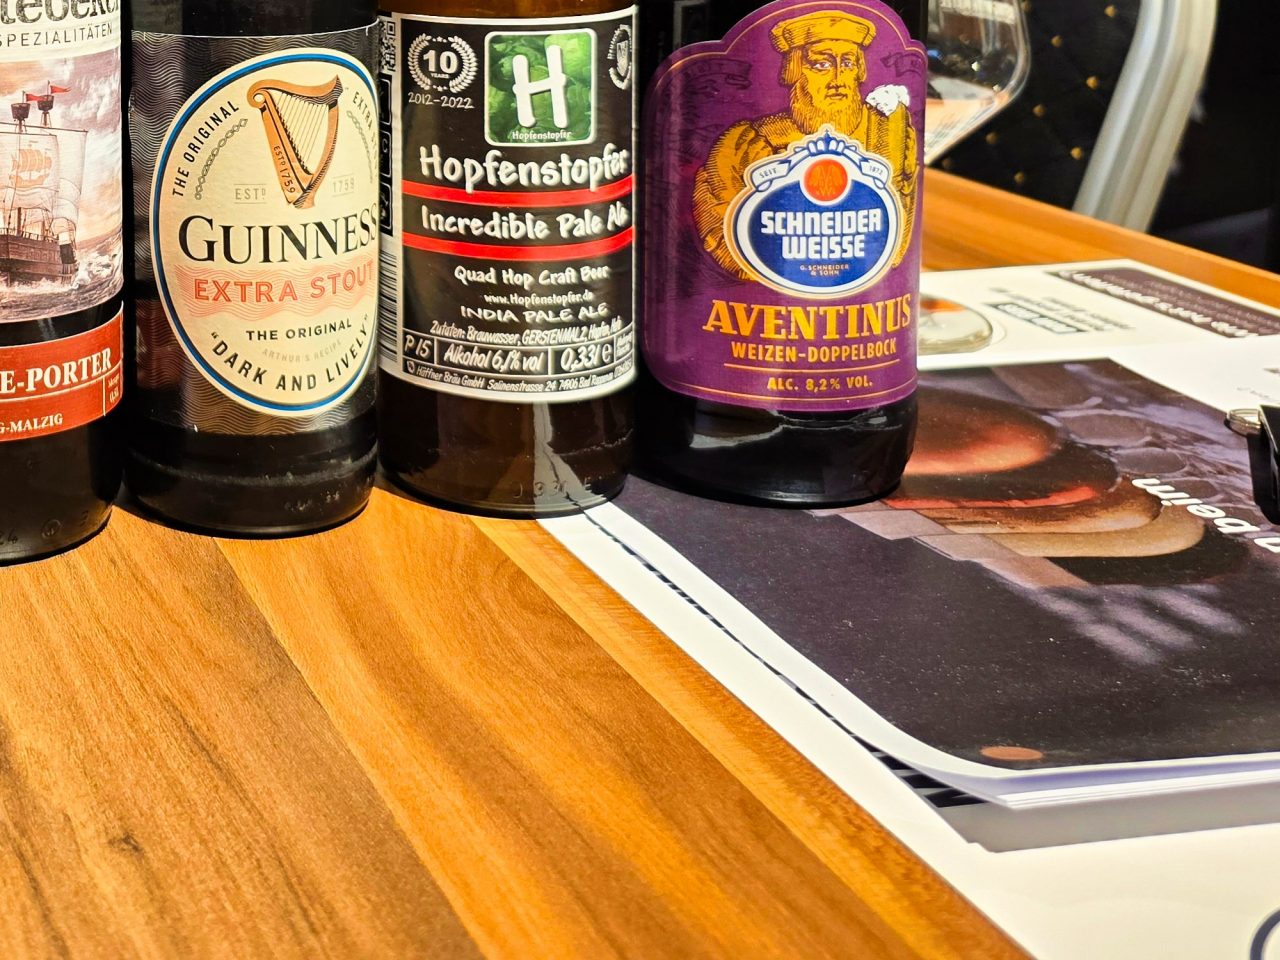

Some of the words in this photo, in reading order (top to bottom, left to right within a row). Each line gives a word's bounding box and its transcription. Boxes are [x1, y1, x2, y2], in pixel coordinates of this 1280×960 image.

[423, 50, 459, 74] 10
[512, 45, 568, 128] H
[407, 92, 475, 110] 2012-2022
[512, 130, 572, 141] Hopfenstopfer
[172, 168, 190, 198] THE
[183, 100, 239, 163] ORIGINAL
[280, 167, 296, 194] 1759
[178, 202, 378, 264] GUINNESS
[422, 204, 551, 240] Incredible
[556, 208, 604, 239] Pale
[760, 208, 881, 234] SCHNEIDER
[782, 234, 865, 260] WEISSE
[454, 265, 497, 285] Quad
[501, 266, 535, 290] Hop
[539, 266, 579, 285] Craft
[808, 263, 849, 271] SCHNEIDER
[194, 278, 298, 303] EXTRA
[310, 260, 374, 301] STOUT
[461, 306, 520, 322] INDIA
[523, 306, 574, 321] PALE
[579, 302, 610, 320] ALE
[702, 293, 911, 340] AVENTINUS
[245, 330, 278, 340] THE
[286, 318, 352, 339] ORIGINAL
[430, 320, 465, 338] Zutaten:
[405, 334, 415, 354] P
[730, 337, 897, 362] WEIZEN-DOPPELBOCK
[443, 344, 490, 369] Alkohol
[522, 353, 547, 371] vol
[276, 374, 318, 392] AND
[443, 370, 461, 384] Bräu
[461, 374, 485, 388] GmbH
[767, 377, 798, 392] ALC.
[845, 375, 873, 389] VOL.
[1131, 477, 1260, 534] beim
